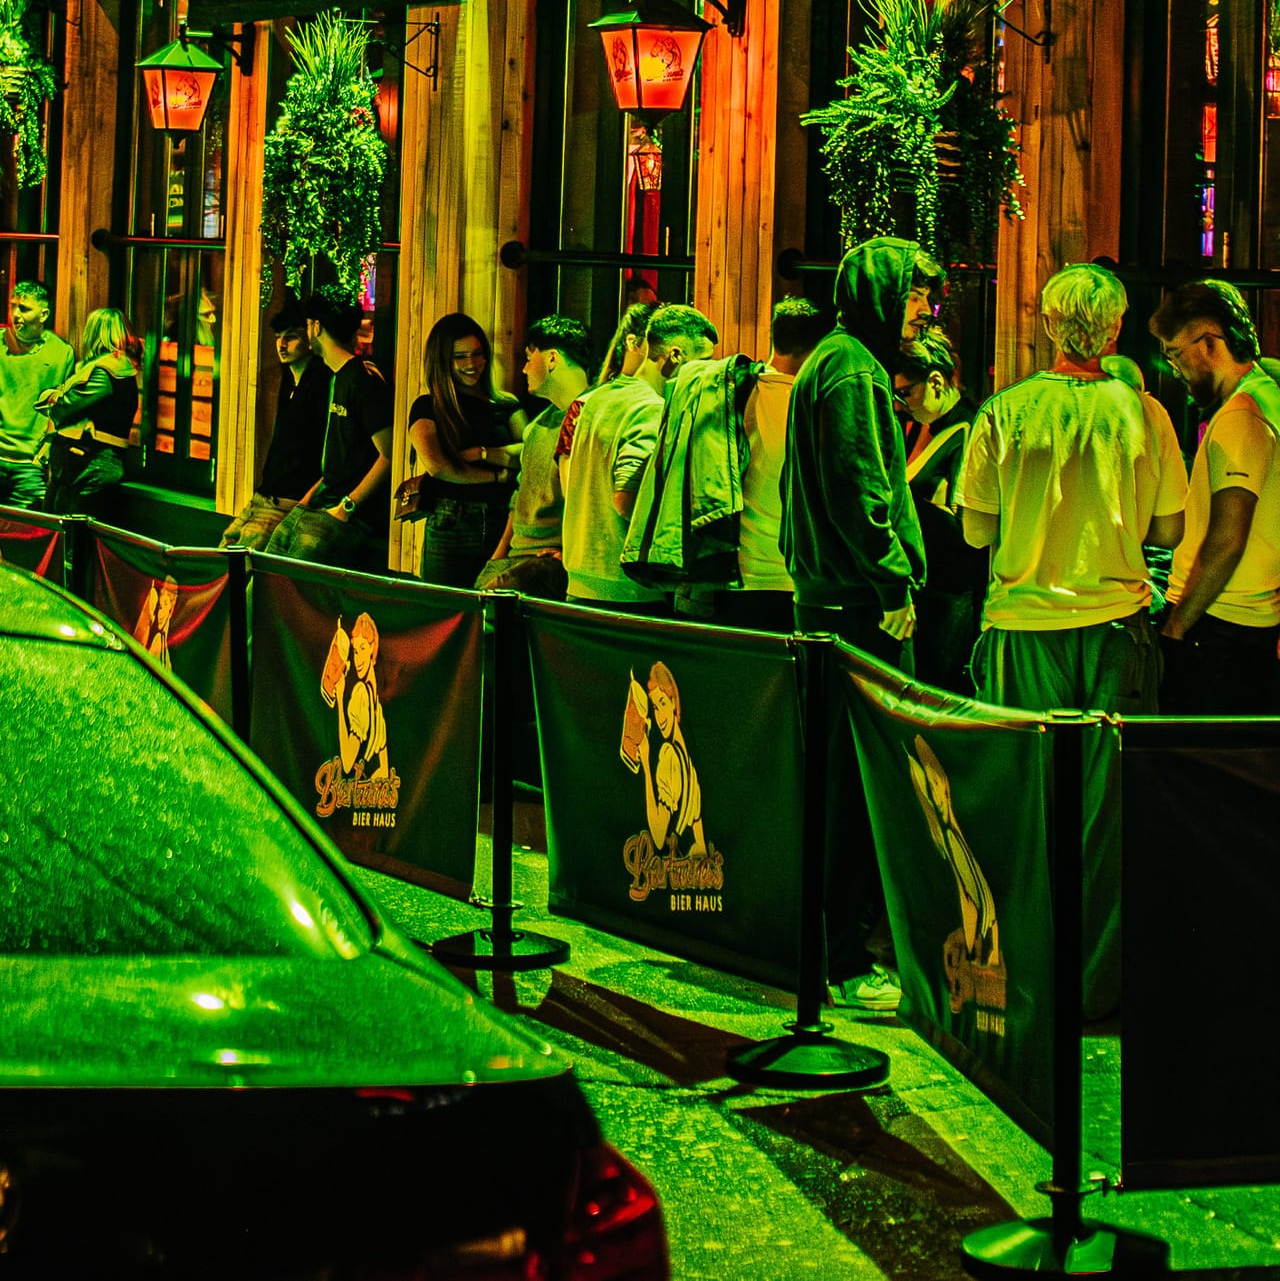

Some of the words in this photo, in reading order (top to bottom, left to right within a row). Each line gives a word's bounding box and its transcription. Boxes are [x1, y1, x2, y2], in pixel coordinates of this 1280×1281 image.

[352, 811, 371, 827] BIER
[373, 812, 396, 828] HAUS
[670, 894, 692, 912] BIER
[695, 894, 723, 912] HAUS
